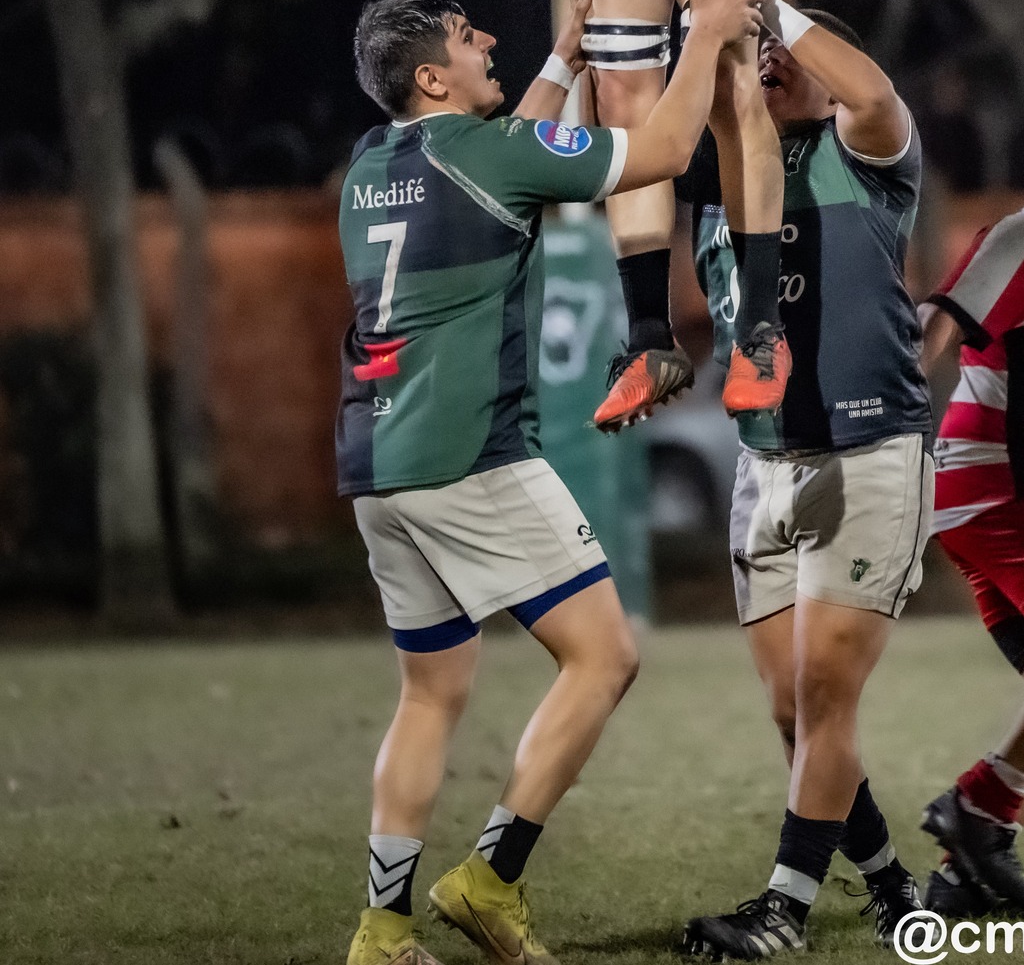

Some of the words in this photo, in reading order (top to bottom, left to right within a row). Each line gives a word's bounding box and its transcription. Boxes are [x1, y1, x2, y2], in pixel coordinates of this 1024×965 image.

[553, 122, 571, 148] MIP
[352, 177, 426, 211] Medifé
[367, 221, 407, 334] 7
[849, 400, 860, 409] QUE
[870, 397, 882, 406] CLUB
